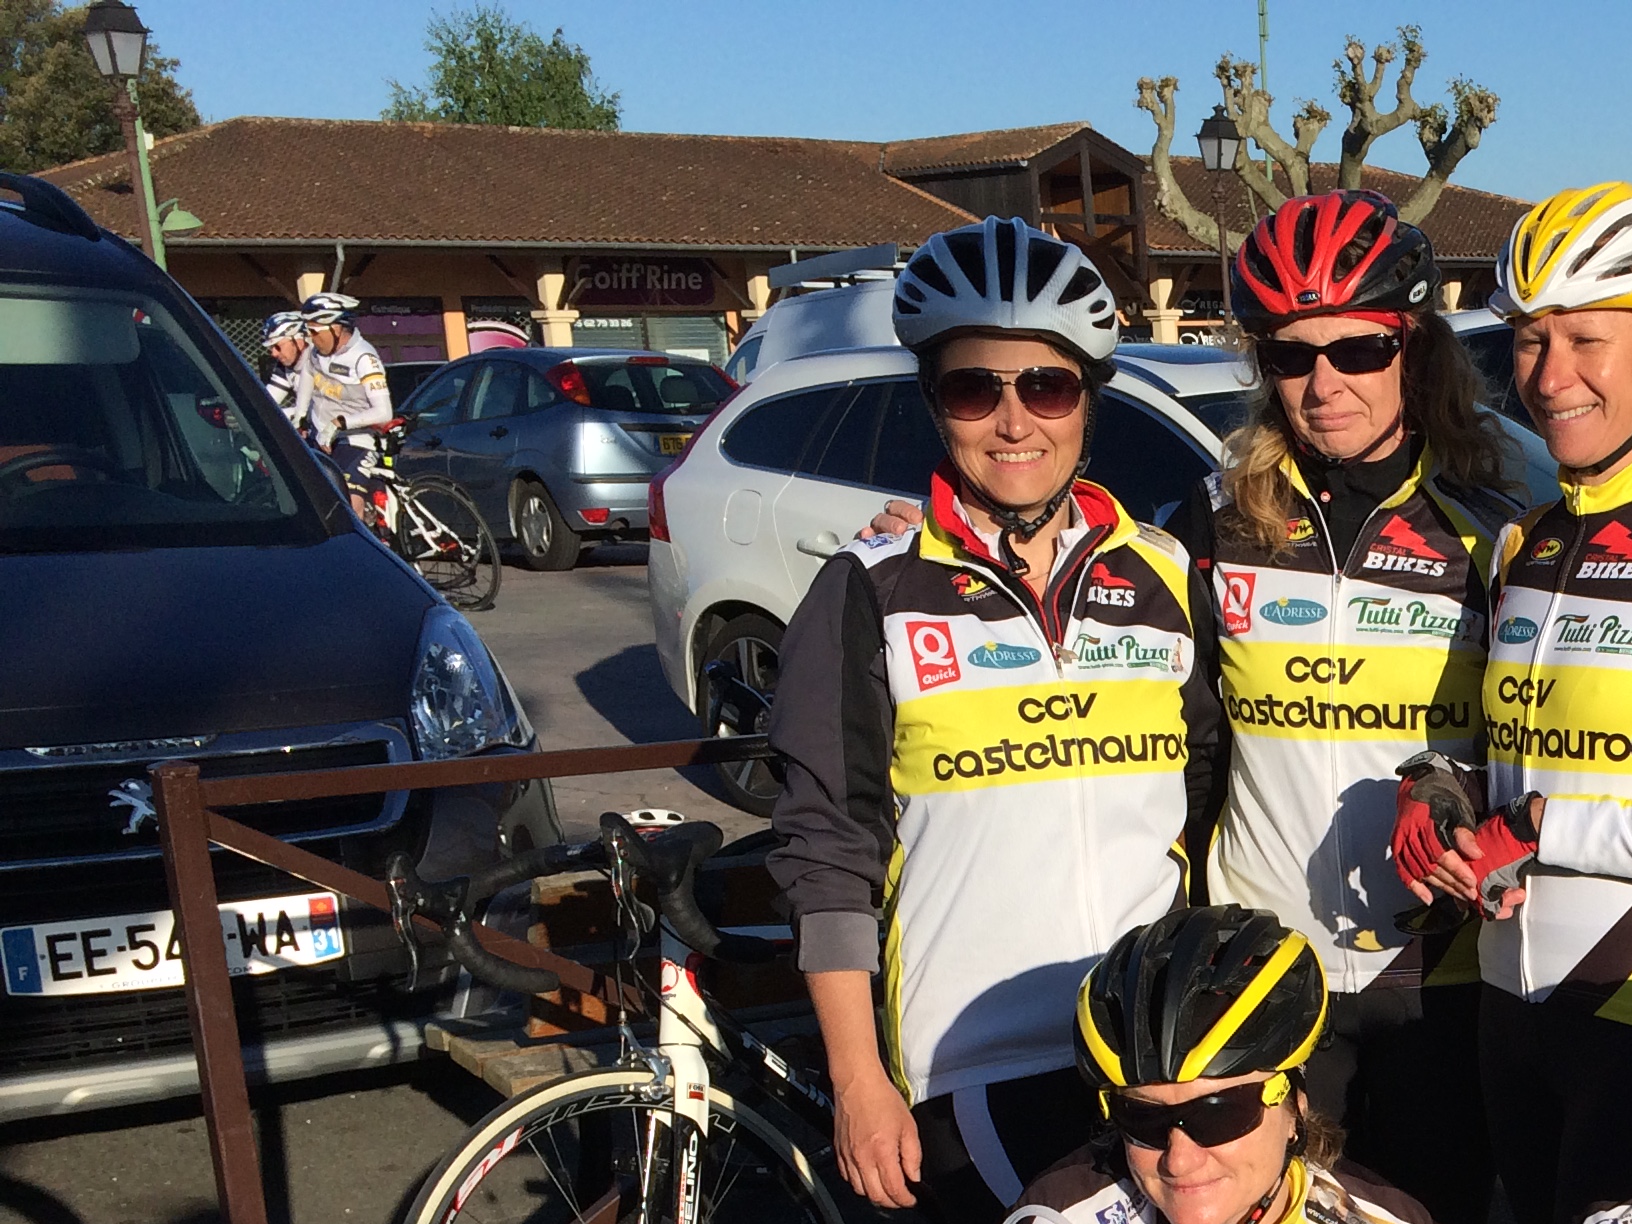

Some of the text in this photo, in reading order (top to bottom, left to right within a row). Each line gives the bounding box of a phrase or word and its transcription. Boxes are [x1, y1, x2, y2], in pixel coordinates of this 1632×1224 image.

[1362, 551, 1448, 578] BIKES
[1086, 586, 1136, 608] IKES
[1347, 596, 1460, 632] Tutti Pizza
[1553, 613, 1598, 644] Tutti
[1076, 633, 1170, 664] Tutti Pizza
[921, 668, 957, 686] Quick
[1228, 694, 1469, 730] castelmaurou
[933, 733, 1188, 781] castelmauro
[312, 928, 340, 951] 31
[17, 966, 29, 981] F
